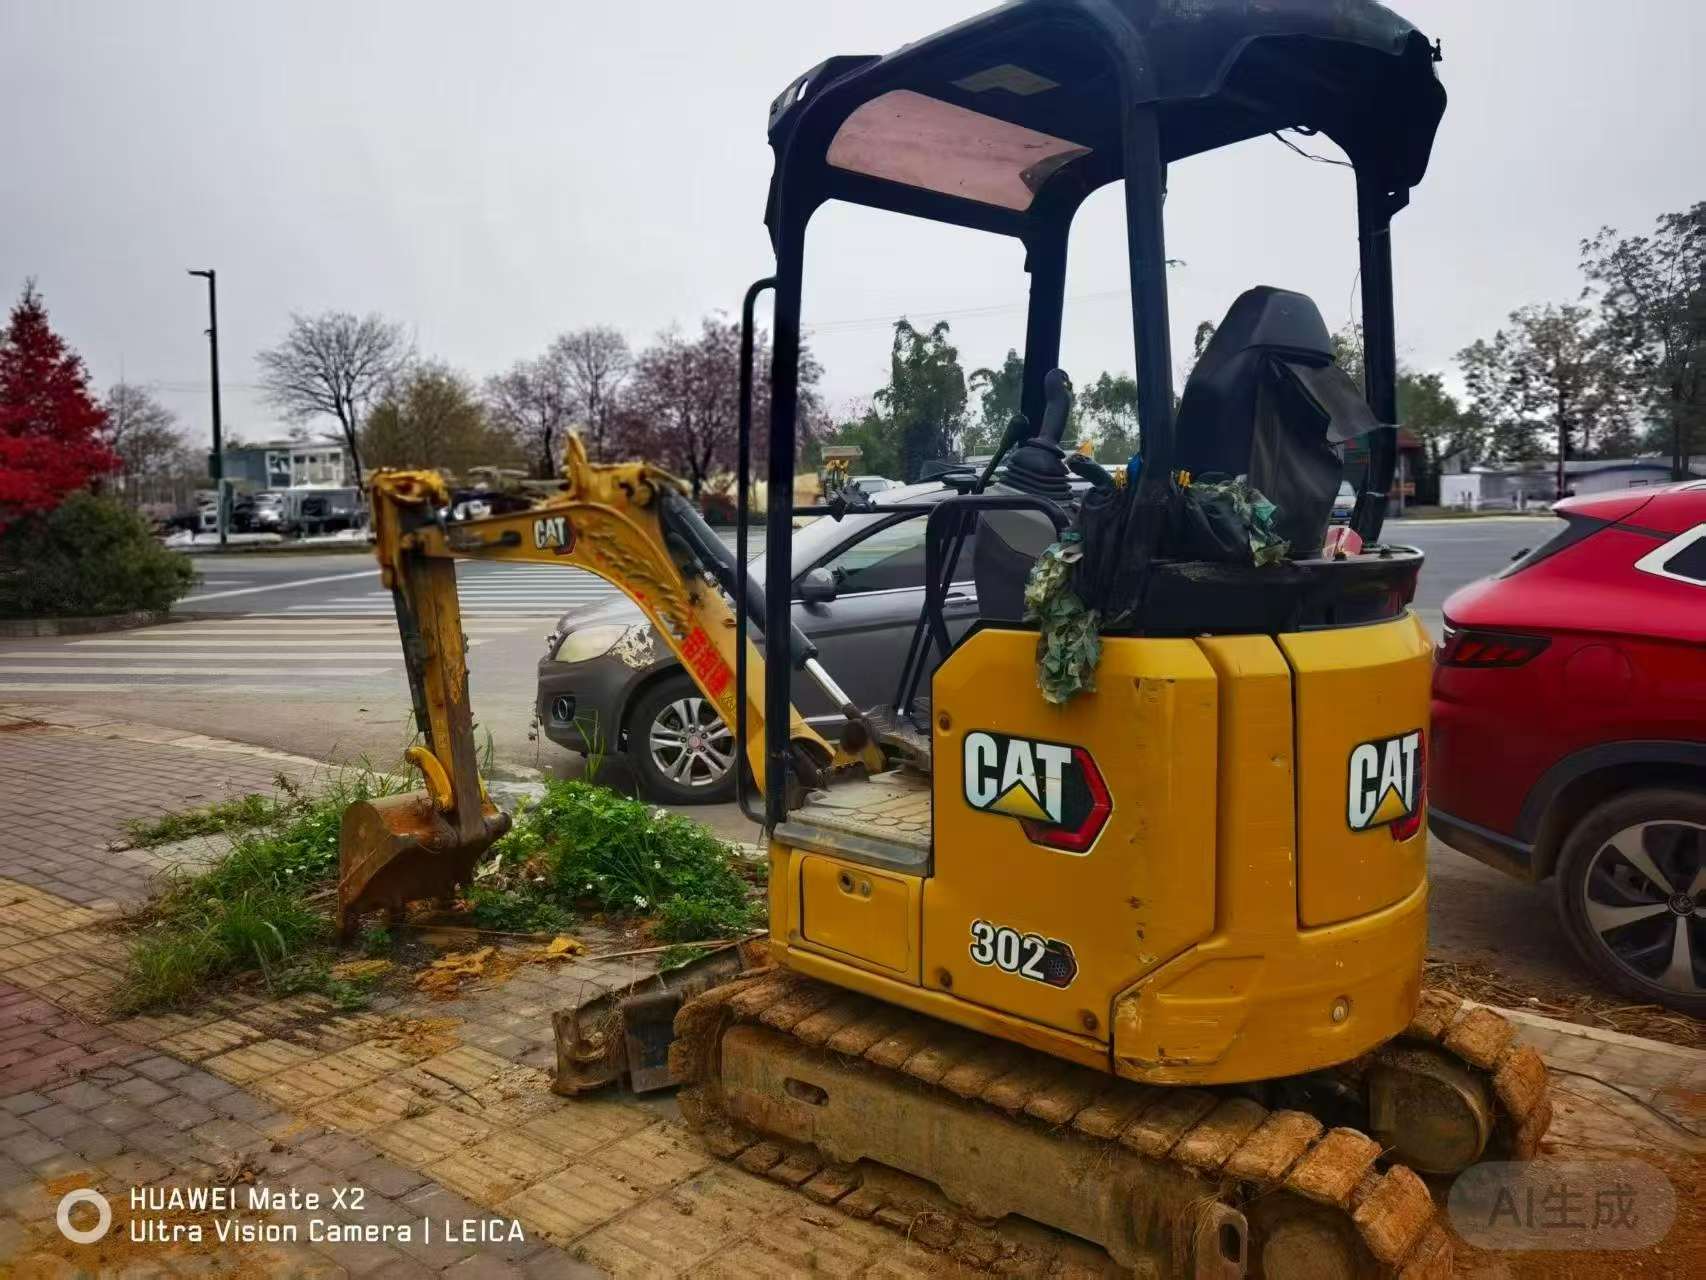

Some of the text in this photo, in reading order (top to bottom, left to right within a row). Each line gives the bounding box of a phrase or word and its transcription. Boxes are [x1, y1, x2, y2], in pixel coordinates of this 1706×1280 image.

[534, 517, 565, 548] CAT
[964, 731, 1072, 823] CAT
[1348, 732, 1420, 830] CAT
[970, 922, 1048, 980] 302
